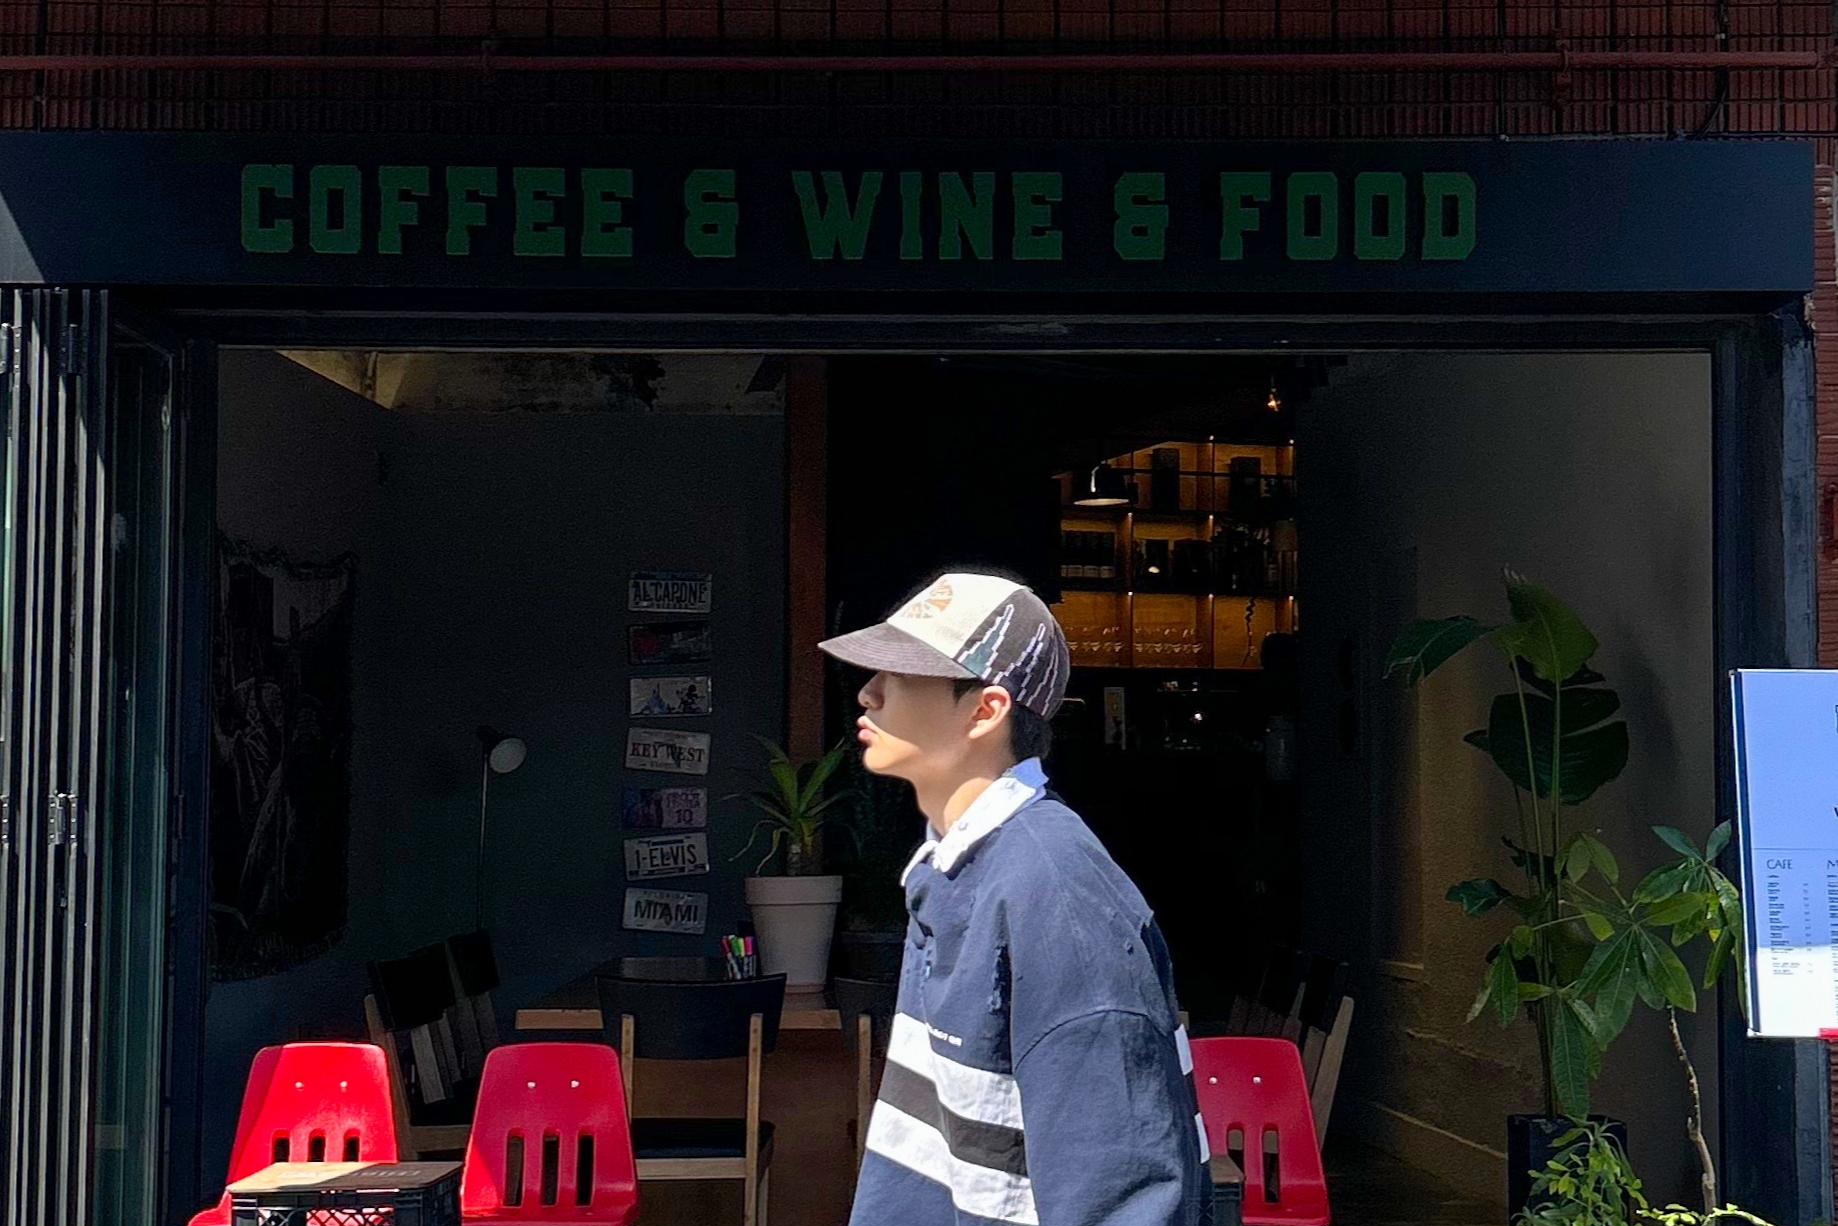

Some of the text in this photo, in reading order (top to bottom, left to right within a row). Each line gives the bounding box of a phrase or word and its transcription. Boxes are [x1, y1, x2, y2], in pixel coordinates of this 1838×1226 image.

[240, 163, 1478, 261] COFFEE & WINE & FOOD
[633, 581, 707, 604] AL CAPONE
[630, 741, 706, 763] KEY WEST
[1766, 858, 1793, 870] CAFE
[634, 900, 698, 923] MIAMI
